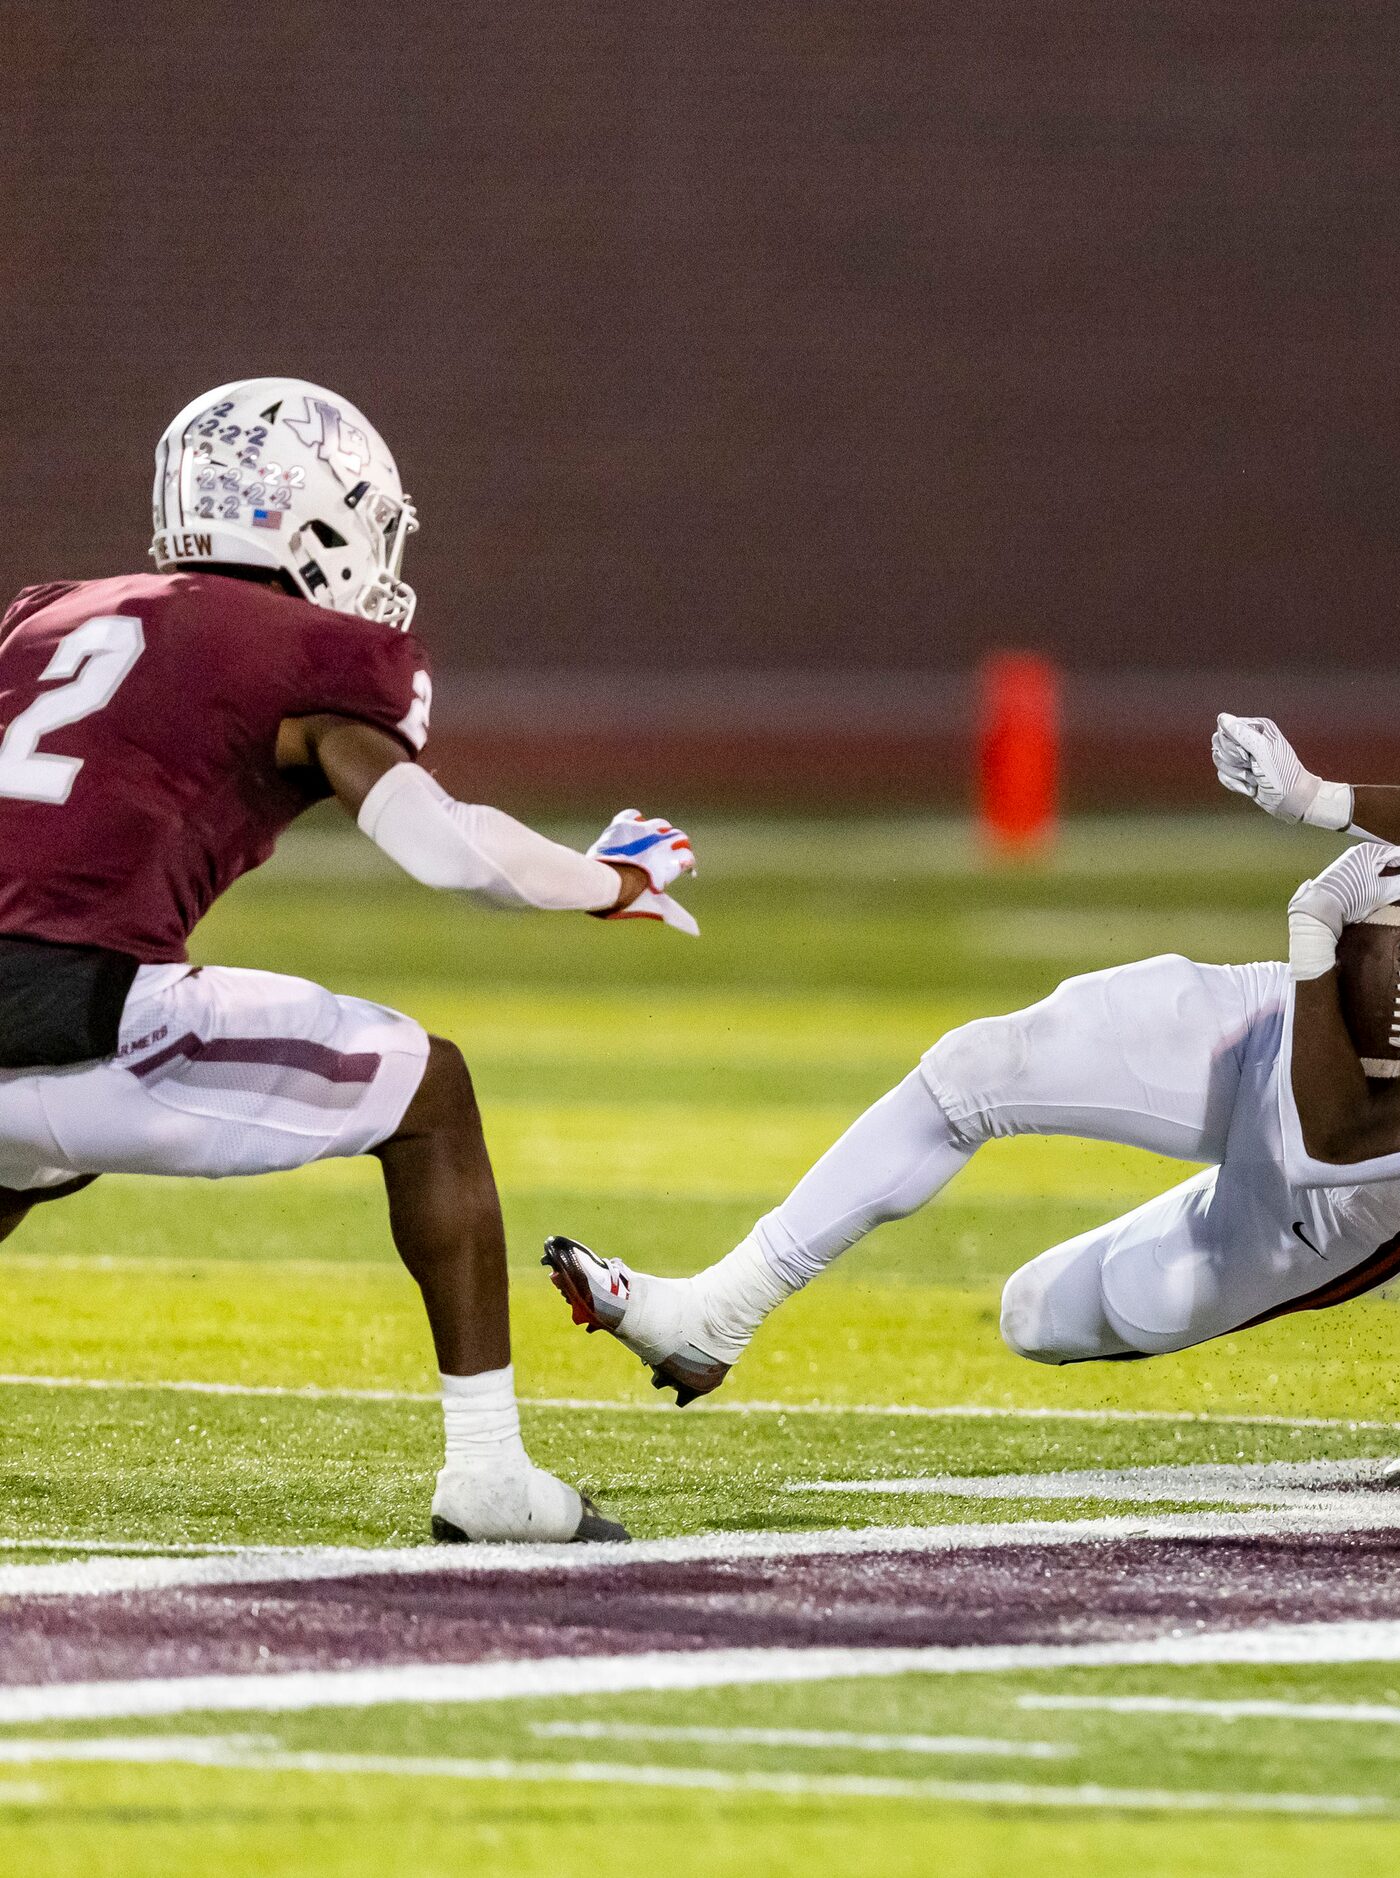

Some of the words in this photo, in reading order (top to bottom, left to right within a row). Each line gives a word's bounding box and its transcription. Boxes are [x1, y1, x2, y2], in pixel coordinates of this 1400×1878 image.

[199, 418, 220, 438] 2
[219, 424, 242, 446] 2
[247, 425, 269, 447] 2
[263, 462, 282, 486] 2
[289, 465, 306, 490] 2
[172, 533, 213, 557] LEW
[0, 614, 146, 805] 2
